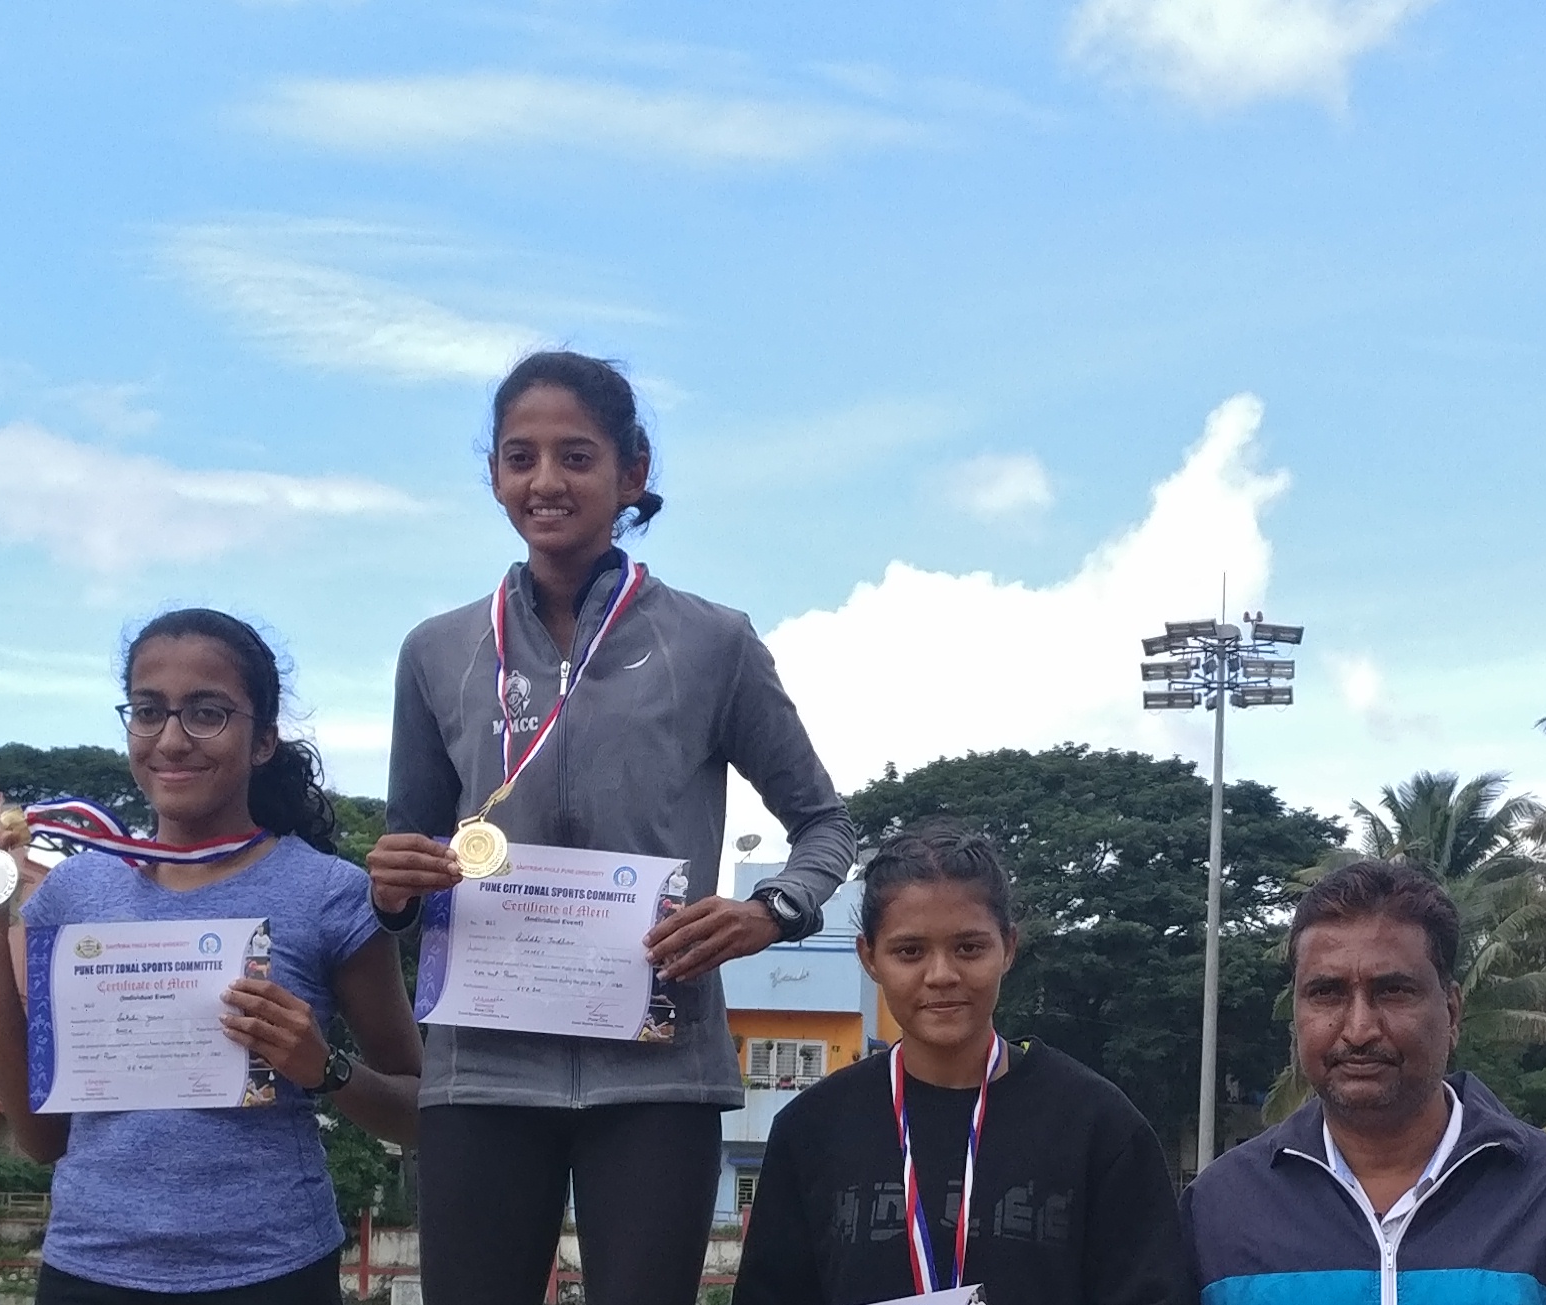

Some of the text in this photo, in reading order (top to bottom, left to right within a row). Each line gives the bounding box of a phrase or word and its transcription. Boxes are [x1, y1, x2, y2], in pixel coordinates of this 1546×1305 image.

[492, 716, 539, 735] MMCC
[479, 881, 637, 904] PUNE CITY ZONAL SPORTS COMMITTEE
[501, 900, 610, 918] Certificate of Merit
[73, 960, 223, 976] PUNE CITY ZONAL SPORTS COMMITTEE
[96, 978, 199, 994] Certificate of Merit
